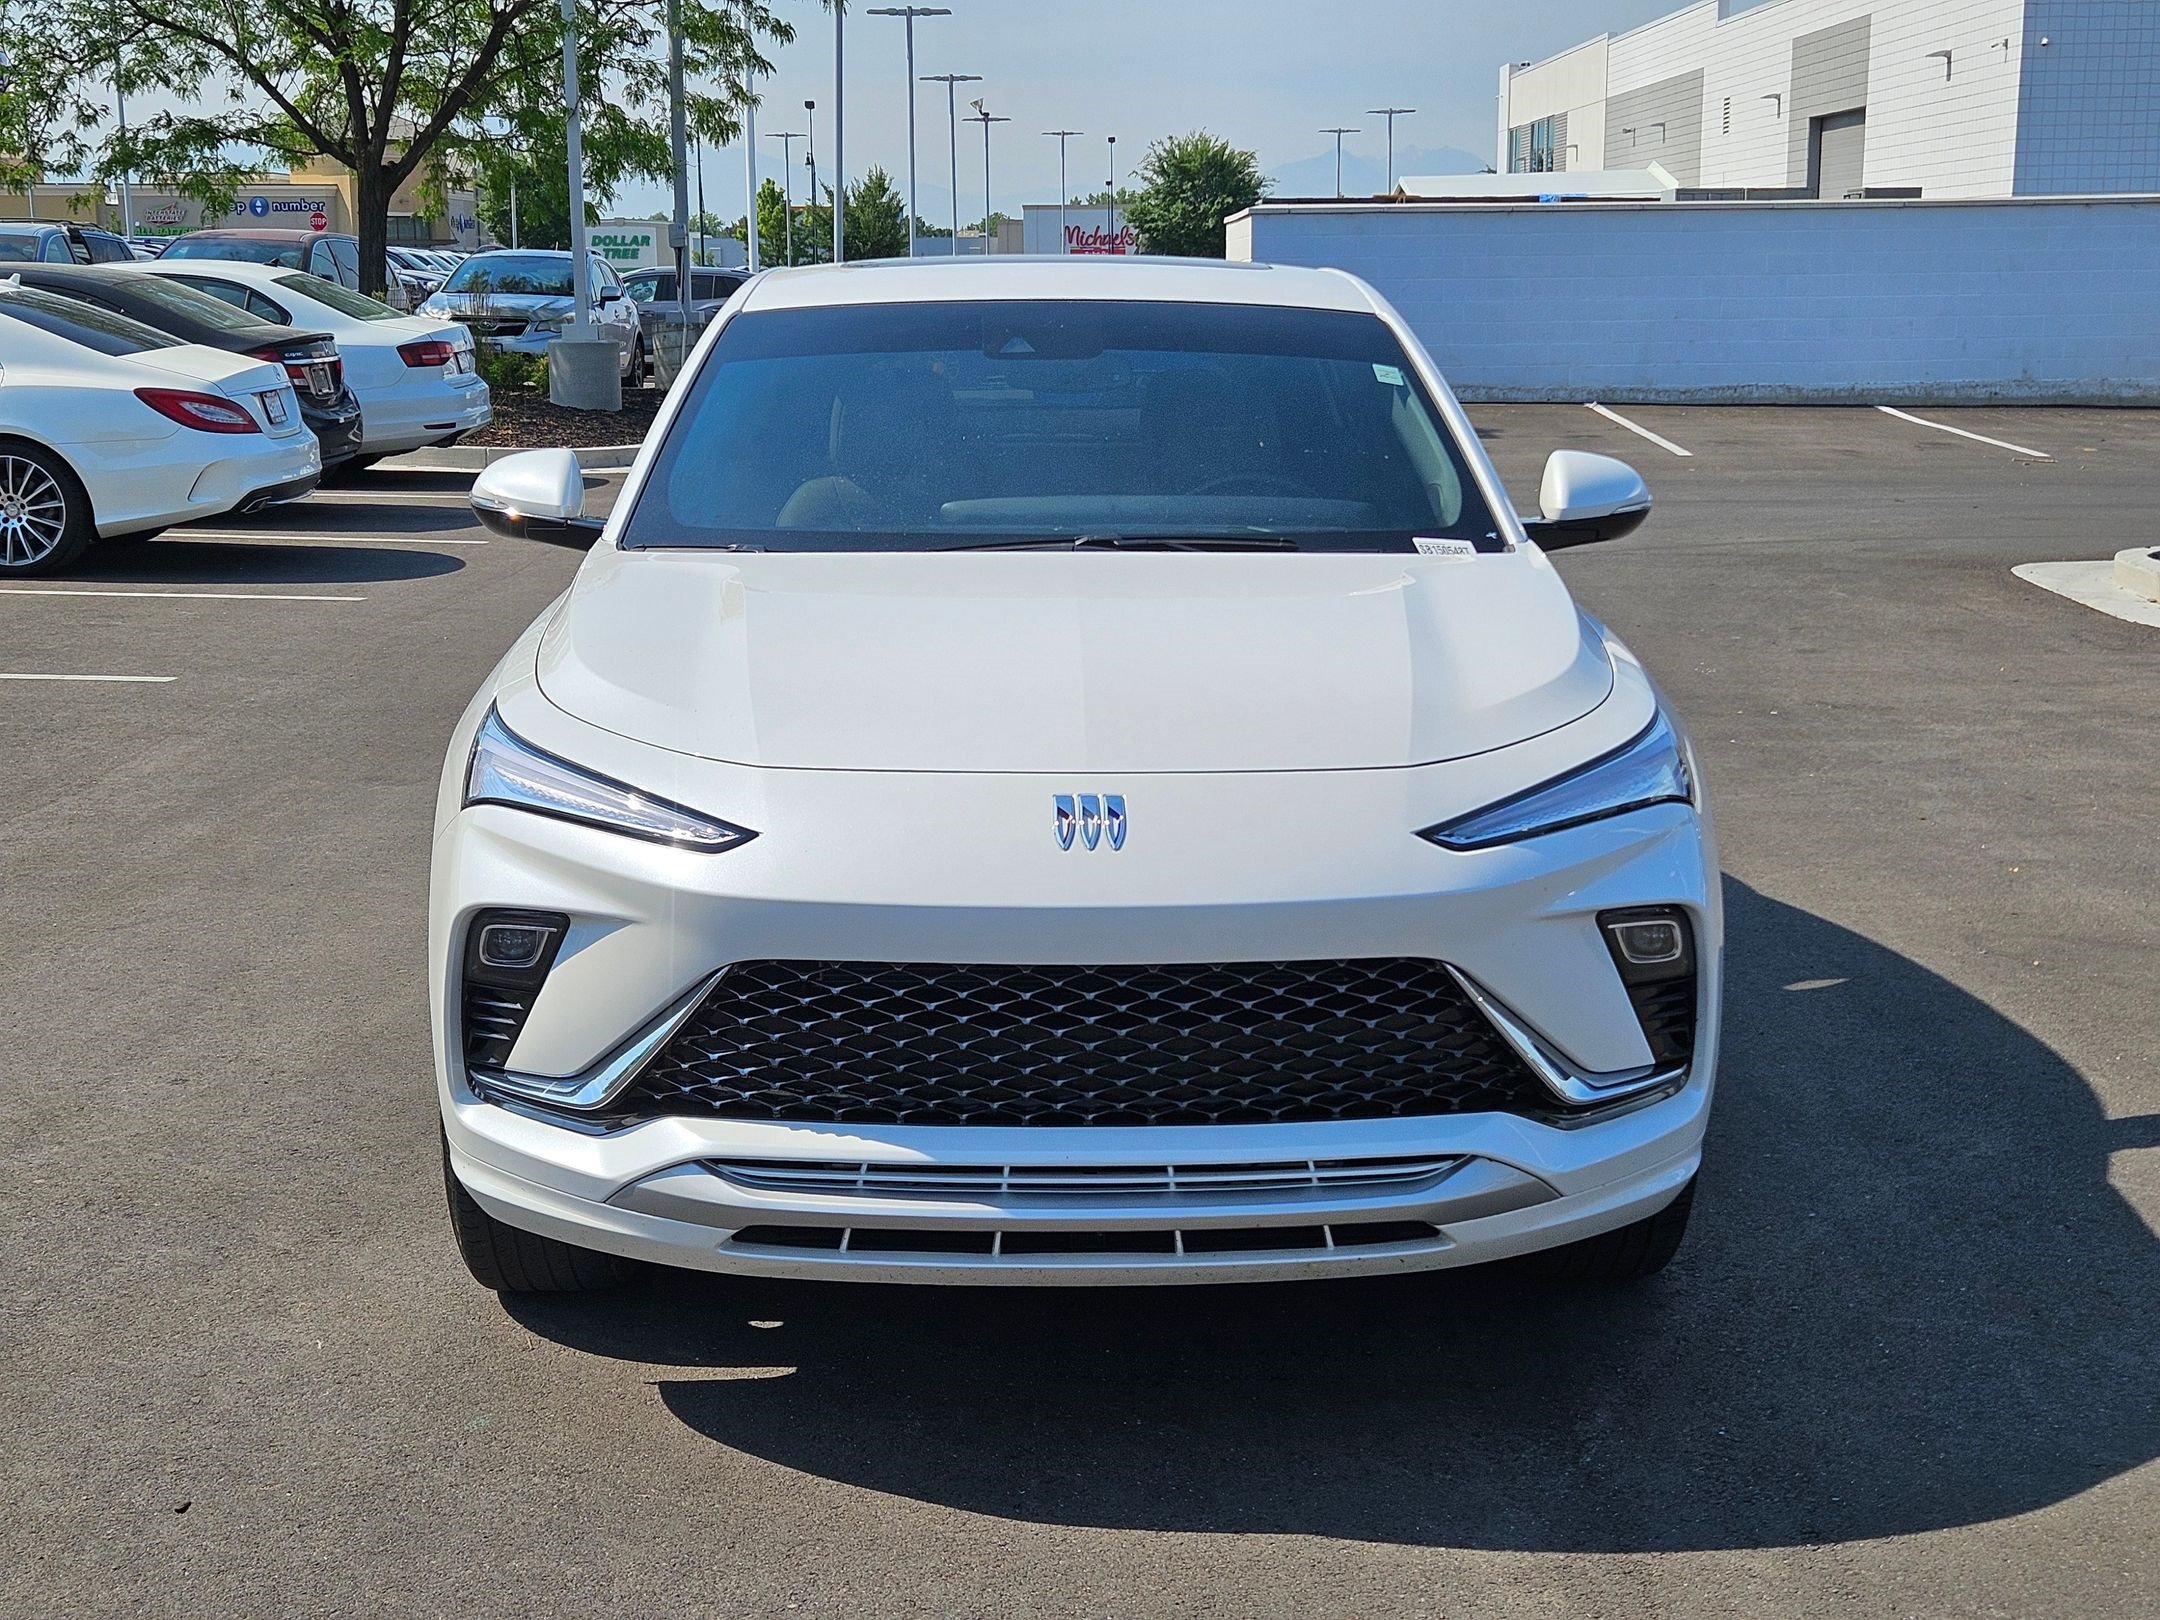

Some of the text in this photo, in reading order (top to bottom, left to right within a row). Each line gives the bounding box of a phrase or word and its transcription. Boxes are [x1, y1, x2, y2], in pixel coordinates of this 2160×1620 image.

[207, 198, 325, 215] sep number
[310, 217, 326, 226] STOP
[134, 227, 152, 235] ALL
[591, 235, 651, 247] DOLLAR
[603, 248, 639, 259] TREE
